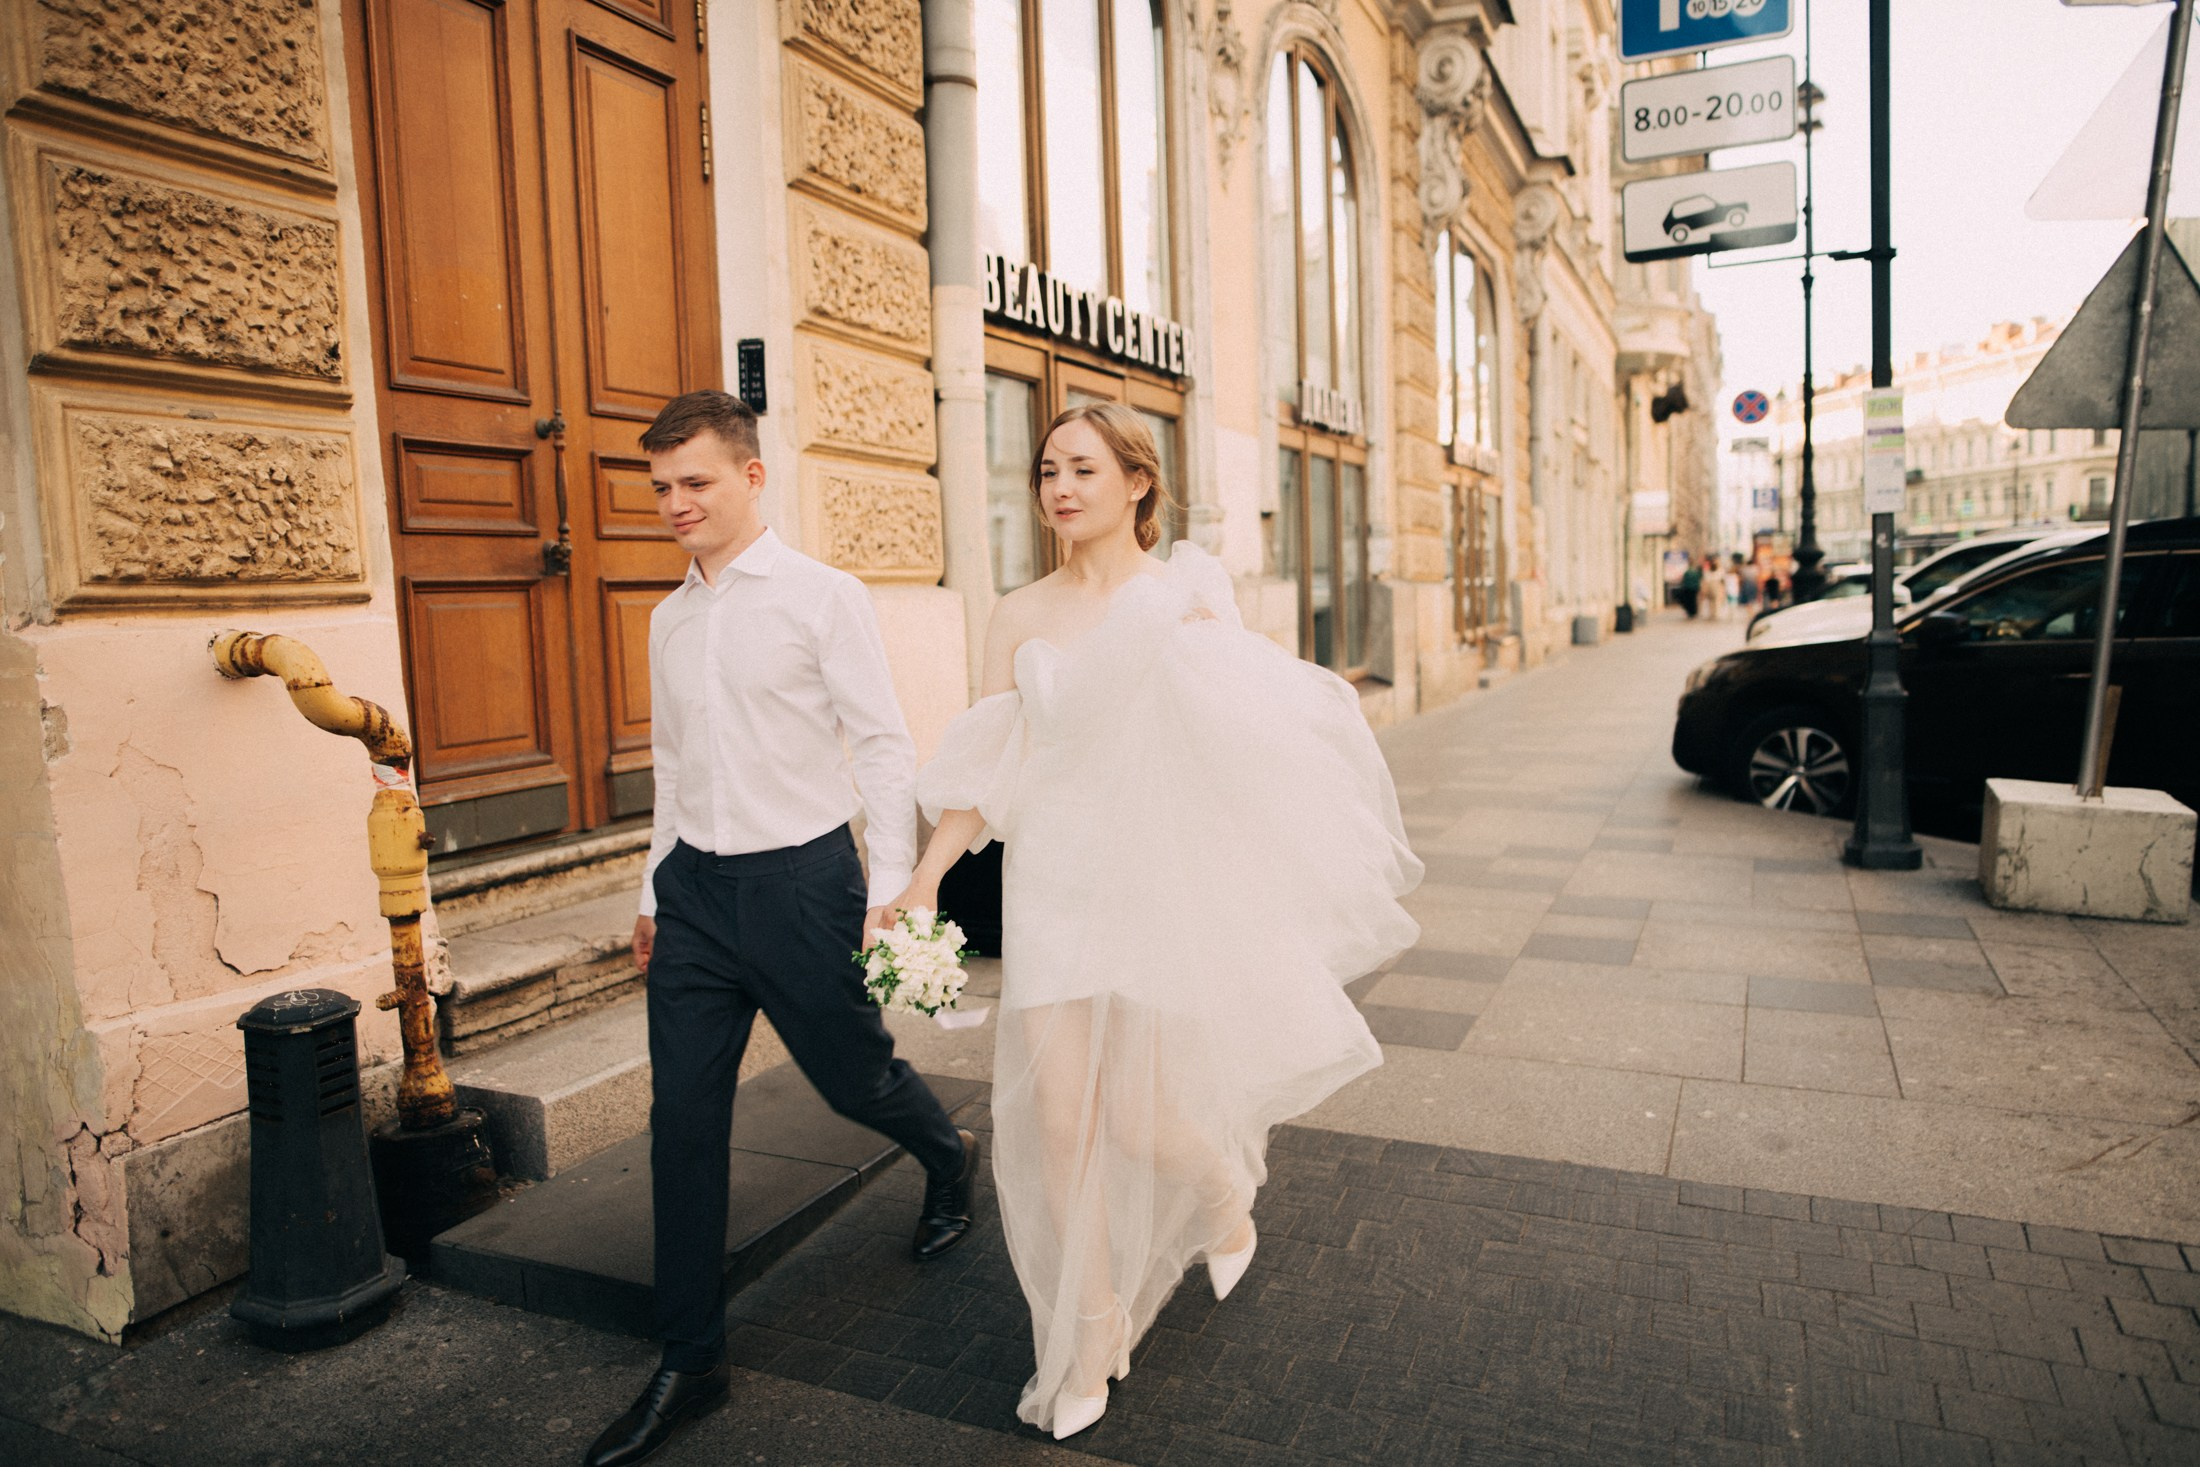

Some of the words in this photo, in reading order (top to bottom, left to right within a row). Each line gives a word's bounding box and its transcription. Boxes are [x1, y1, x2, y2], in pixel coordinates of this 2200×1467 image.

[1634, 90, 1783, 133] 8.00-20.00
[983, 250, 1104, 348] BEAUTY
[1106, 295, 1195, 377] CENTER
